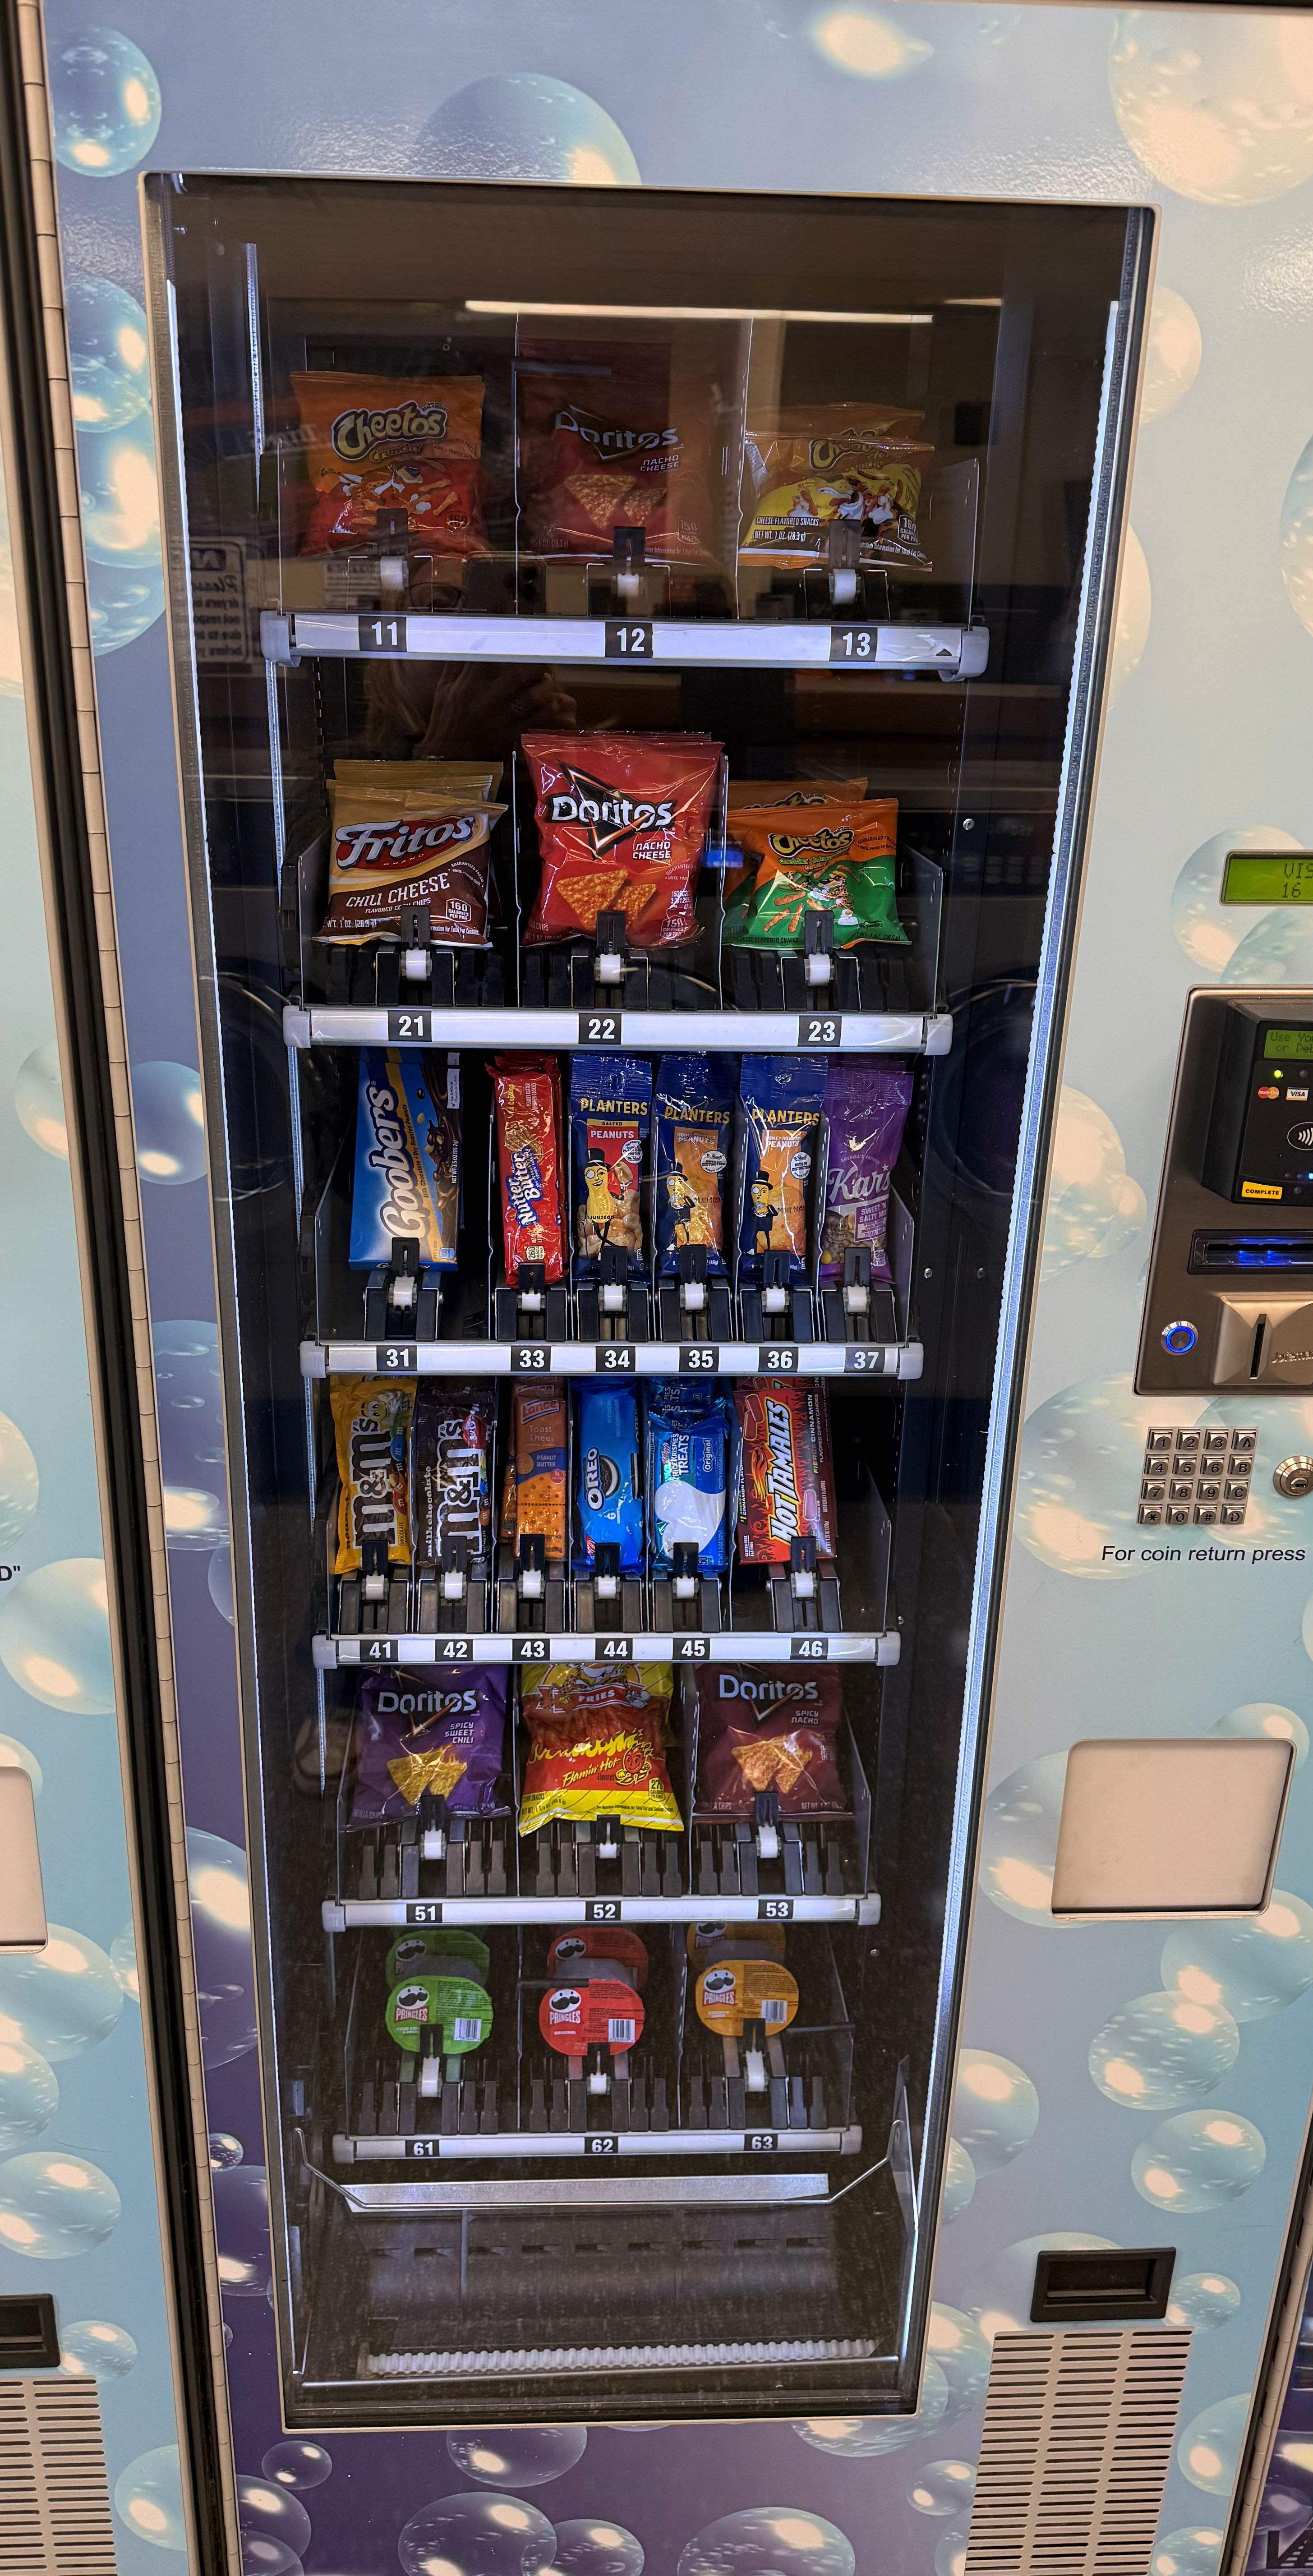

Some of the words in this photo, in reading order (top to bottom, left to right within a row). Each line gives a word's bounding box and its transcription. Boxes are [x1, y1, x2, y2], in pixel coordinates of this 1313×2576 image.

[336, 404, 442, 456] Cheetos
[555, 411, 679, 449] Doritos
[640, 461, 679, 472] CHEESE
[643, 455, 679, 465] NACHO
[756, 517, 774, 525] CHEESE
[774, 517, 800, 526] FLAVORED
[800, 518, 819, 527] SNACKS
[371, 621, 397, 645] 11
[617, 628, 645, 652] 12
[843, 632, 870, 656] 13
[551, 796, 674, 829] Doritos
[336, 817, 474, 867] Fritos
[635, 841, 671, 851] NACHO
[773, 832, 850, 853] Cheetos
[632, 851, 671, 860] CHEESE
[346, 893, 382, 907] CHILI
[387, 872, 450, 903] CHEESE
[1281, 882, 1301, 898] 16
[450, 901, 468, 912] 160
[666, 918, 683, 928] 150
[399, 1015, 423, 1036] 21
[588, 1018, 615, 1039] 22
[808, 1021, 835, 1042] 23
[1271, 1031, 1291, 1041] Use
[401, 1104, 412, 1125] Peanuts
[580, 1098, 648, 1116] PLANTERS
[664, 1105, 730, 1124] PLANTERS
[751, 1108, 820, 1126] PLANTERS
[406, 1125, 416, 1146] Roasted
[590, 1130, 634, 1139] PEANUTS
[678, 1136, 714, 1145] PEANUTS
[369, 1085, 427, 1238] Goobers
[415, 1160, 427, 1187] Chocolate
[514, 1152, 541, 1201] Butter
[508, 1178, 536, 1224] Nutter
[861, 1204, 880, 1215] SWEET
[859, 1213, 877, 1223] SALTY
[386, 1348, 409, 1367] 31
[520, 1349, 544, 1368] 33
[605, 1350, 630, 1368] 34
[688, 1350, 713, 1368] 35
[767, 1351, 792, 1369] 36
[854, 1351, 879, 1369] 37
[522, 1400, 558, 1418] Lance
[807, 1394, 816, 1442] CINNAMON
[671, 1433, 679, 1461] KRISPIES
[766, 1399, 800, 1502] TAMALES
[1161, 1439, 1165, 1447] 1
[1187, 1439, 1194, 1448] 2
[1214, 1439, 1222, 1448] 3
[1242, 1439, 1251, 1448] A
[678, 1435, 690, 1475] TREATS
[704, 1440, 713, 1470] Original
[1155, 1464, 1163, 1472] 4
[1183, 1464, 1192, 1473] 5
[1211, 1464, 1219, 1473] 6
[1238, 1464, 1248, 1473] B
[587, 1448, 603, 1510] OREO
[1152, 1489, 1160, 1497] 7
[1179, 1488, 1188, 1498] 8
[1207, 1489, 1216, 1498] 9
[1235, 1488, 1244, 1498] C
[770, 1493, 798, 1542] HOT
[1176, 1513, 1184, 1522] 0
[1230, 1513, 1240, 1522] D
[1101, 1546, 1135, 1561] For
[1141, 1546, 1181, 1561] coin
[1189, 1546, 1245, 1561] return
[1252, 1549, 1306, 1564] press
[369, 1641, 391, 1658] 41
[443, 1641, 467, 1658] 42
[521, 1641, 545, 1657] 43
[604, 1641, 628, 1657] 44
[681, 1640, 705, 1656] 45
[798, 1640, 823, 1657] 46
[719, 1674, 819, 1700] Doritos
[378, 1690, 477, 1714] Doritos
[578, 1690, 616, 1702] FRIES
[450, 1722, 474, 1730] SPICY
[562, 1764, 598, 1787] Flamin'
[599, 1757, 622, 1771] Hot
[415, 1905, 435, 1921] 51
[593, 1904, 616, 1918] 52
[766, 1902, 788, 1917] 53
[704, 1991, 735, 2005] PRINGLES
[395, 2007, 428, 2022] PRINGLES
[549, 2010, 581, 2024] PRINGLES
[413, 2141, 433, 2156] 61
[592, 2139, 613, 2153] 62
[751, 2135, 773, 2149] 63
